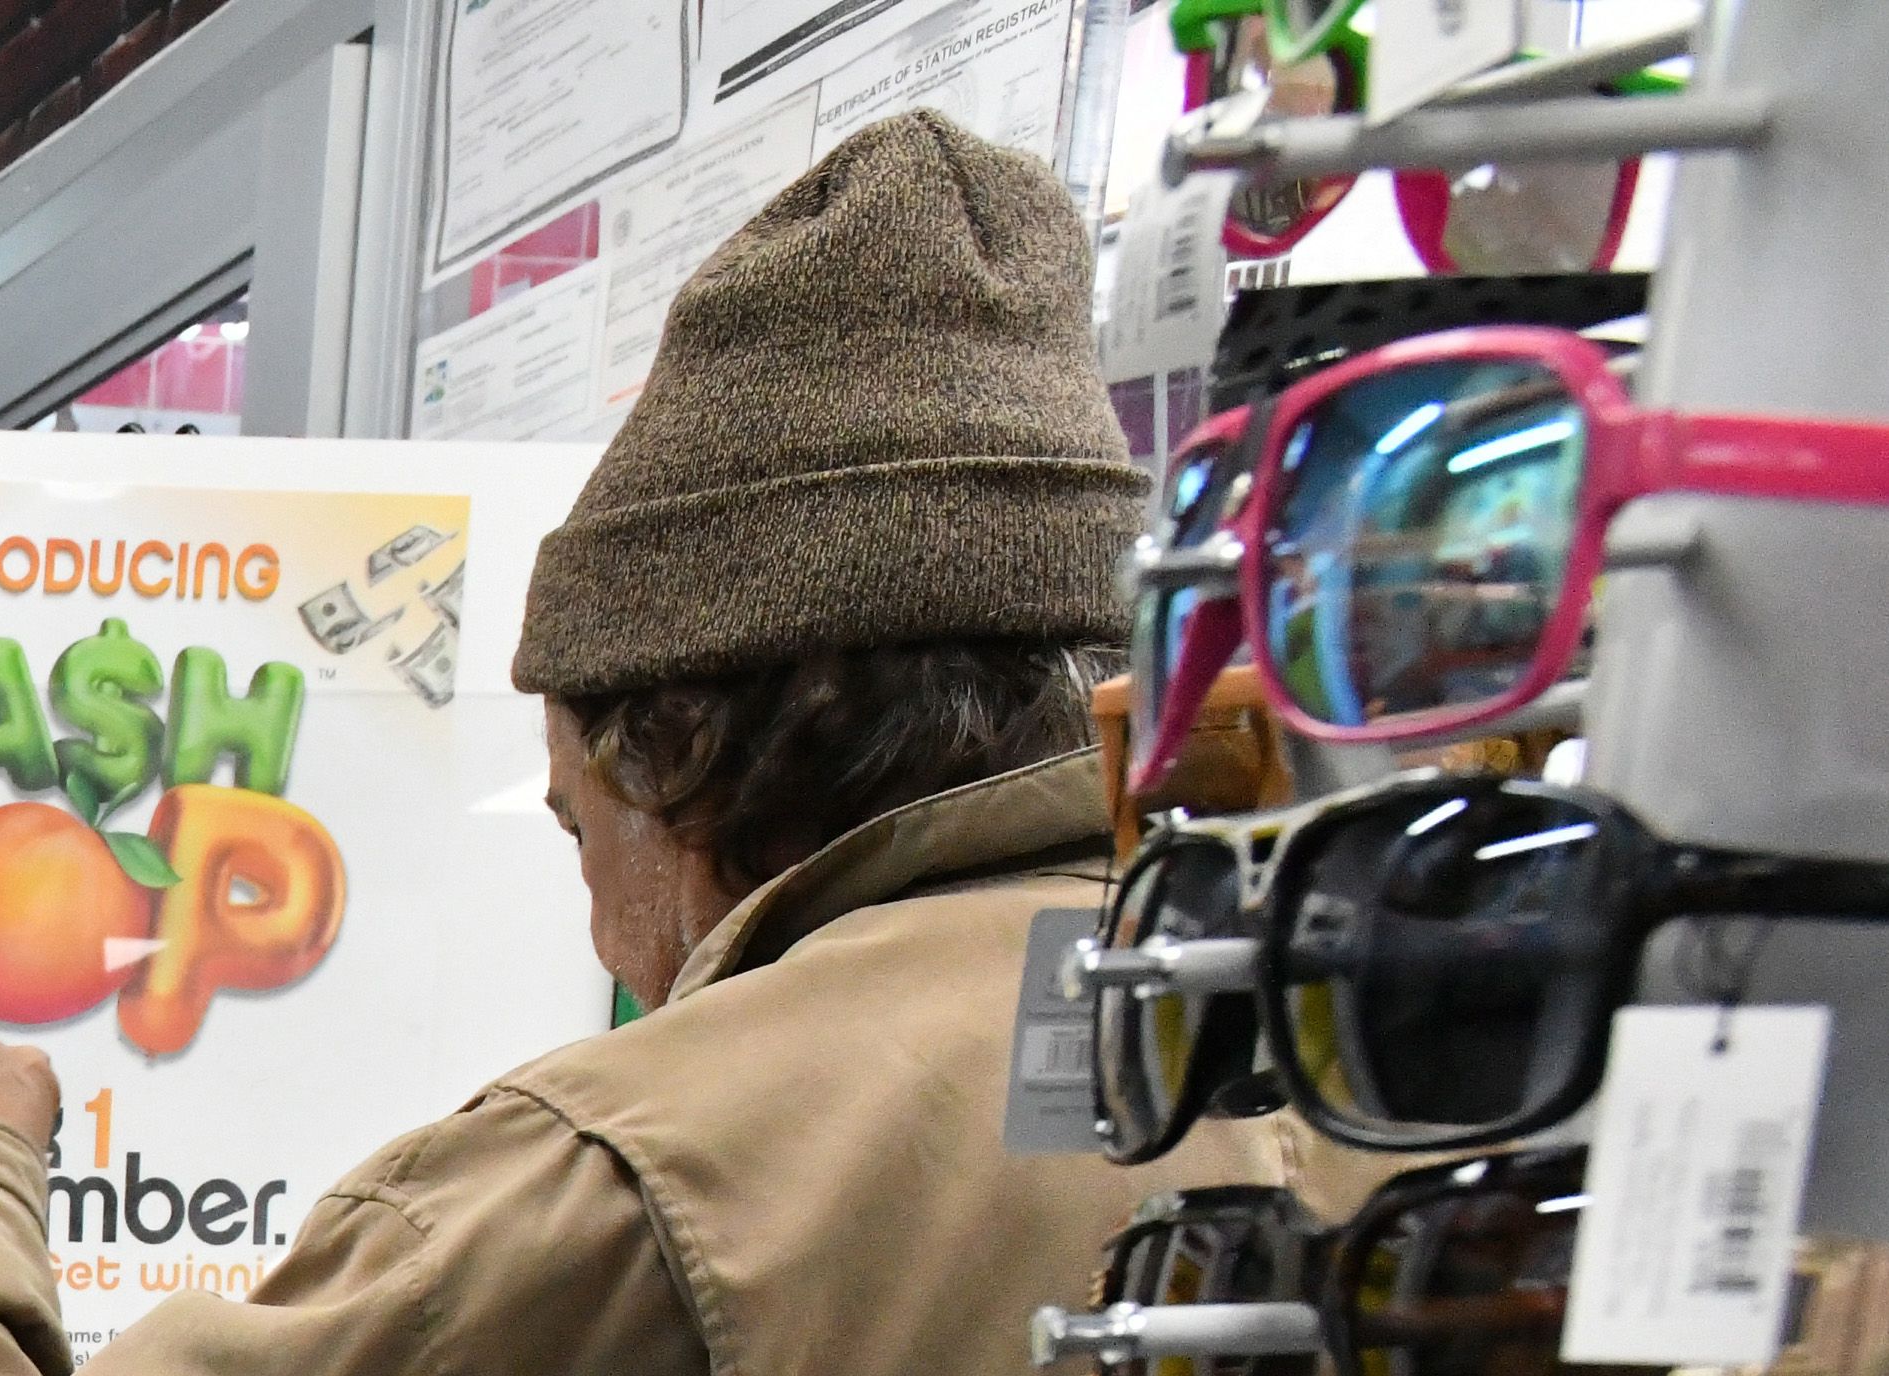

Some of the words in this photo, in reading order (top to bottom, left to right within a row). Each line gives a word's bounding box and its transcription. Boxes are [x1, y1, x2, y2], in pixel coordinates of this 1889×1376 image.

[818, 75, 892, 127] CERTIFICATE
[894, 66, 912, 85] OF
[914, 35, 973, 75] STATION
[976, 0, 1064, 44] REGISTRATI
[85, 1088, 112, 1168] 1
[47, 1151, 287, 1247] mber.
